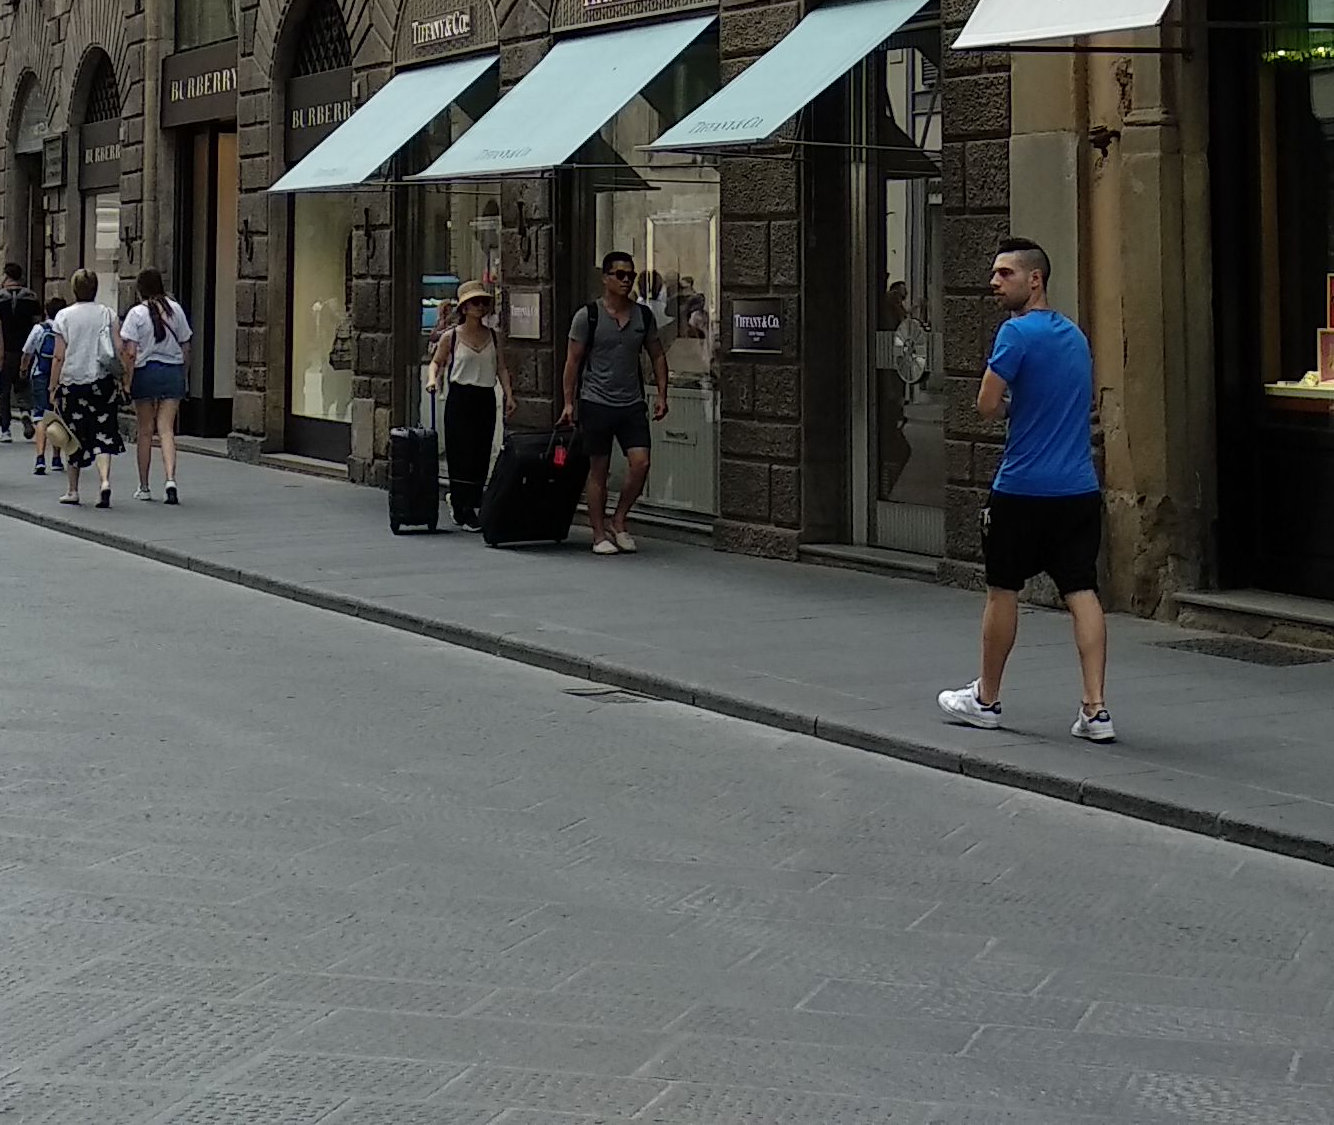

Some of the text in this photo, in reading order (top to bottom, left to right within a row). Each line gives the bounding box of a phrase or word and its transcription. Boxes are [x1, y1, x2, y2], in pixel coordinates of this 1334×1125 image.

[170, 66, 238, 103] BURBERRY
[291, 100, 352, 129] BURBERR
[85, 143, 121, 164] BURBERR
